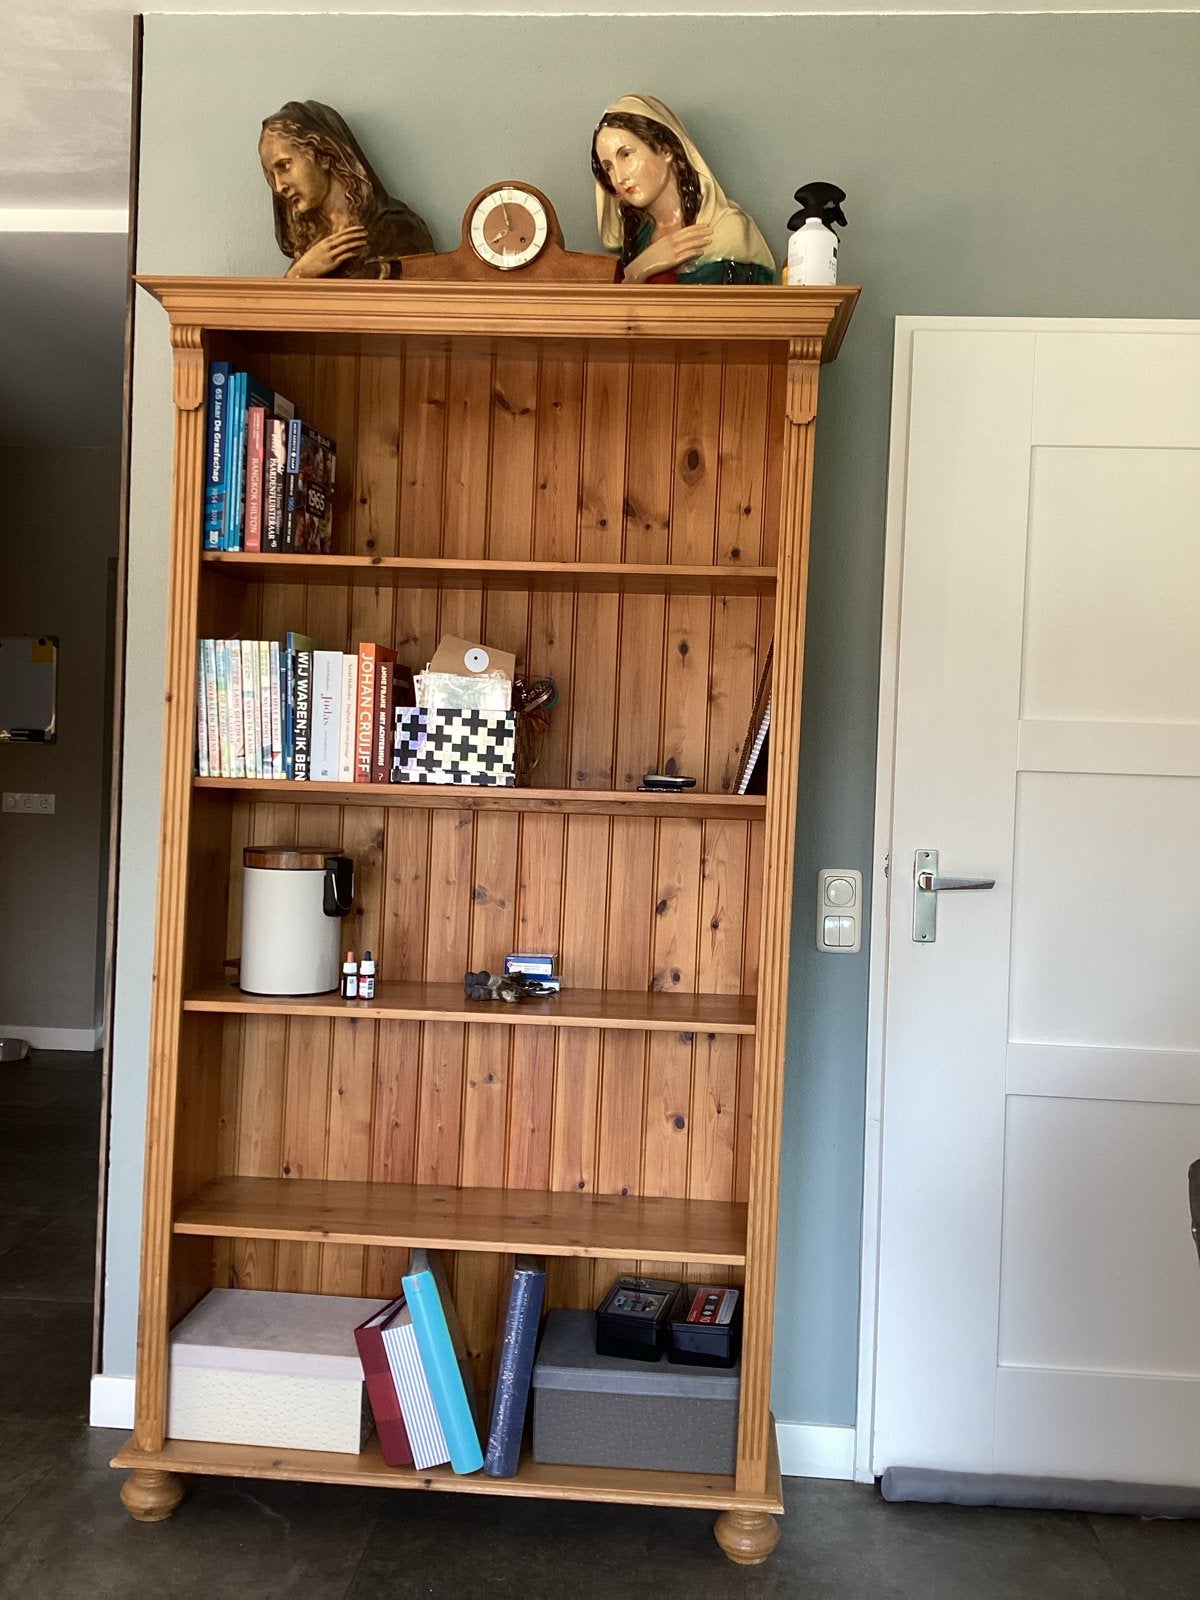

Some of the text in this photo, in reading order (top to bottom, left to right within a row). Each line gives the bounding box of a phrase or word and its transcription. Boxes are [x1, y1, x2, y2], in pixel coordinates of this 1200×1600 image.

[211, 388, 222, 482] 65 Jaar De Graafschap
[250, 458, 259, 500] BANGKOK
[267, 457, 277, 540] PAARDENFLUISTERAAR
[249, 502, 258, 534] HILTON
[308, 489, 325, 512] 1965
[380, 666, 388, 685] ANNE
[294, 652, 309, 781] WIJ WAREN, IK BEN
[321, 693, 334, 726] Judas
[358, 652, 373, 773] JOHAN CRUIJFF
[378, 725, 386, 766] ACHTERHUIS
